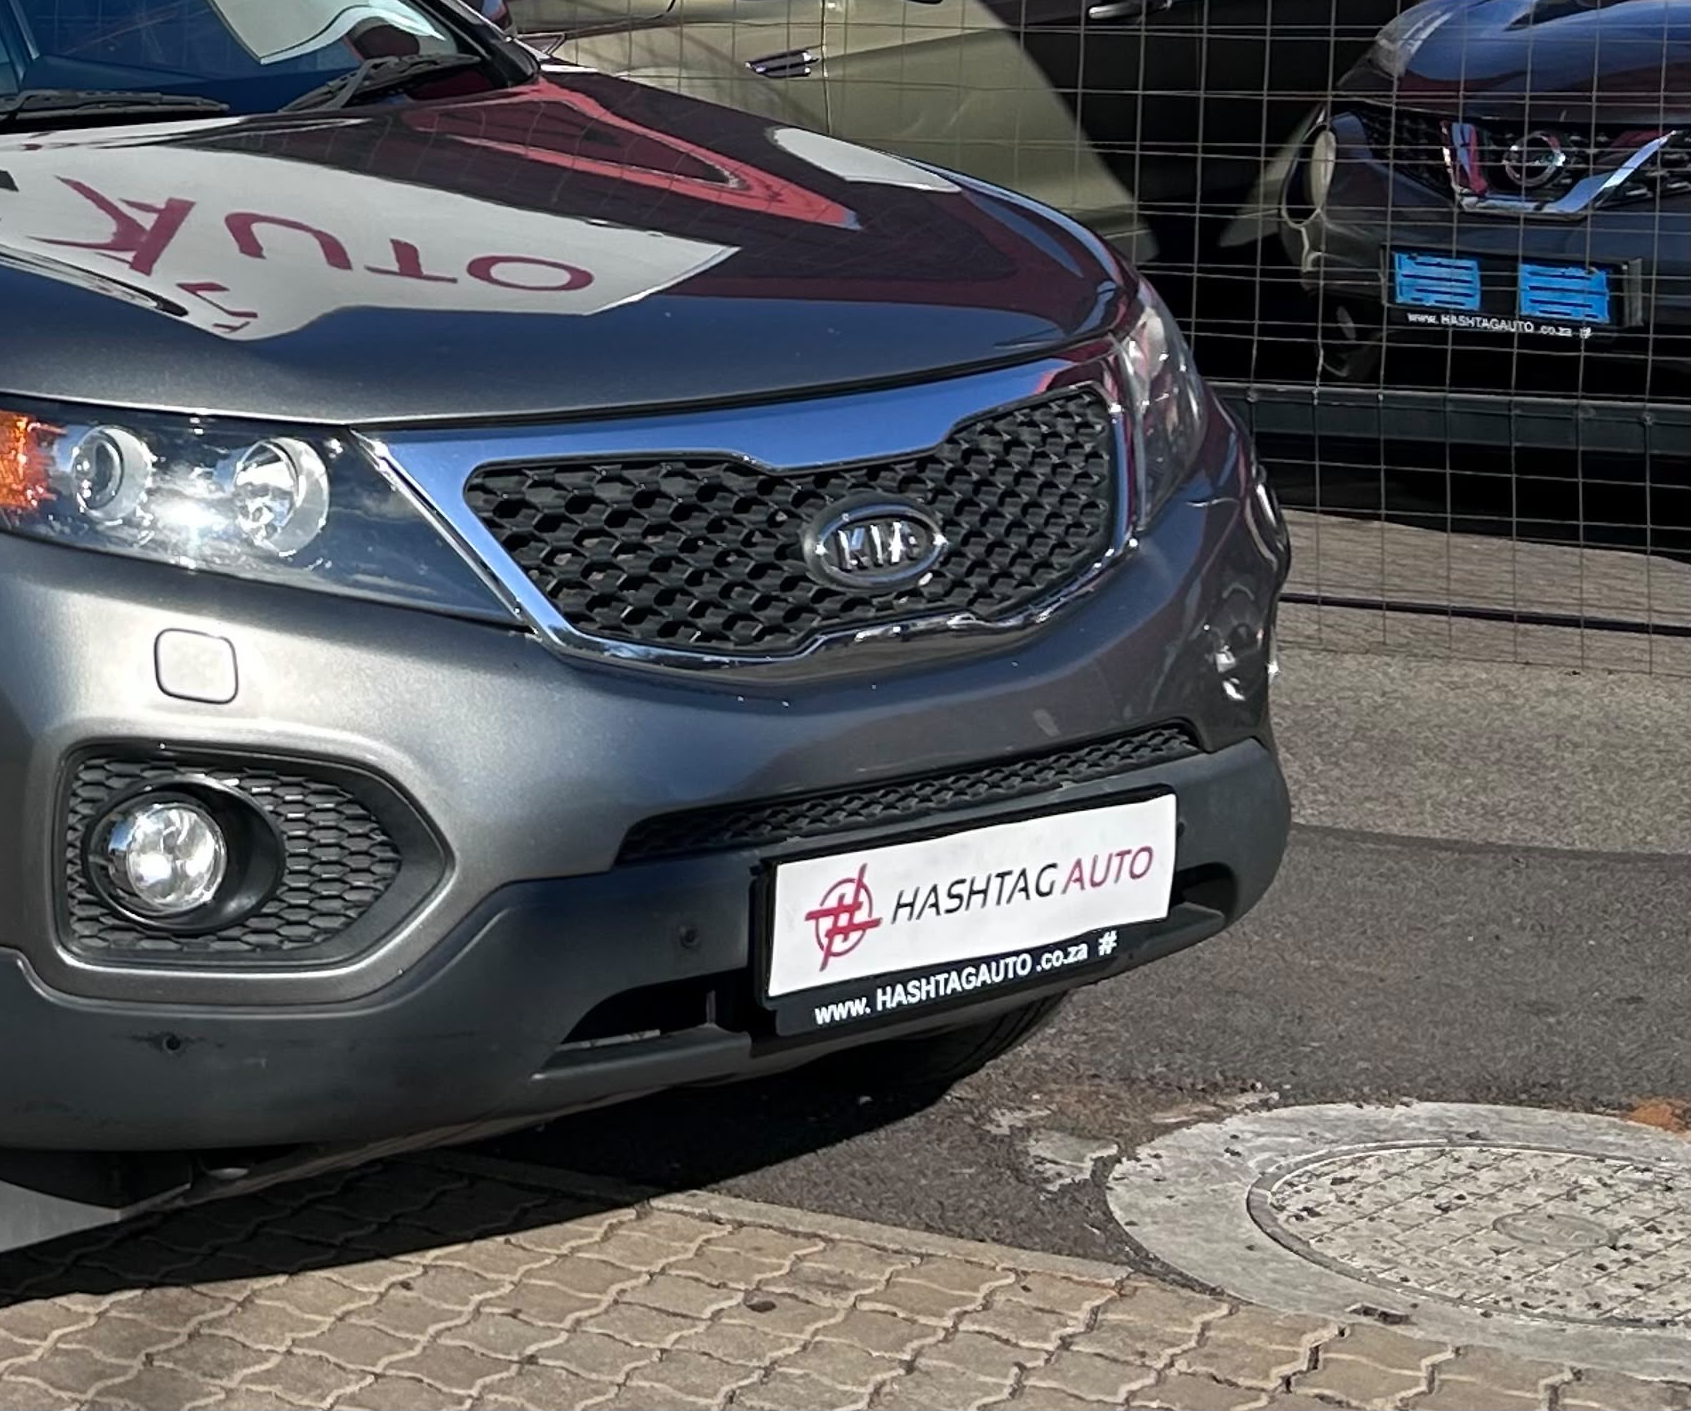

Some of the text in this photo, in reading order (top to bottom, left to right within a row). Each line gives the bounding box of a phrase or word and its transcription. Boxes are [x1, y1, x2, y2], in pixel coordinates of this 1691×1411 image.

[1441, 314, 1534, 333] HASHTAGAUTO
[833, 520, 921, 573] KIA
[890, 845, 1154, 925] HASHTAG AUTO
[814, 994, 871, 1026] www.
[876, 952, 1033, 1012] HASHTAGAUTO
[1036, 942, 1088, 973] .co.za
